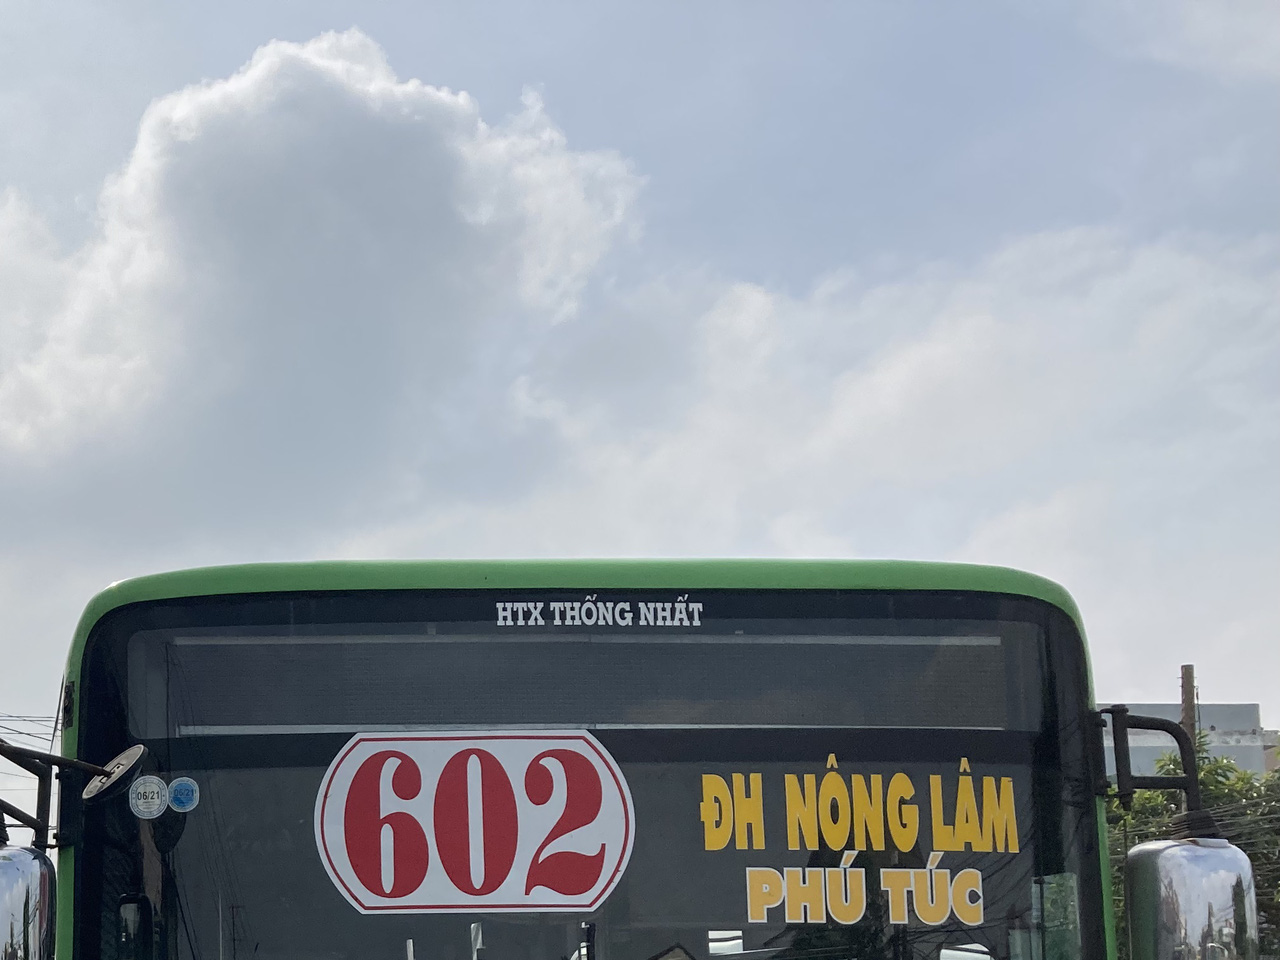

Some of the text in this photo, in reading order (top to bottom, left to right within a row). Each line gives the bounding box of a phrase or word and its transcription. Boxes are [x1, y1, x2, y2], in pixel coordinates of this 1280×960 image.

[496, 594, 703, 626] HTX THỐNG NHẤT
[137, 790, 160, 801] 06/21
[344, 748, 606, 898] 602
[700, 753, 1019, 853] ĐH NÔNG LÂM
[746, 850, 984, 926] PHÚ TÚC
